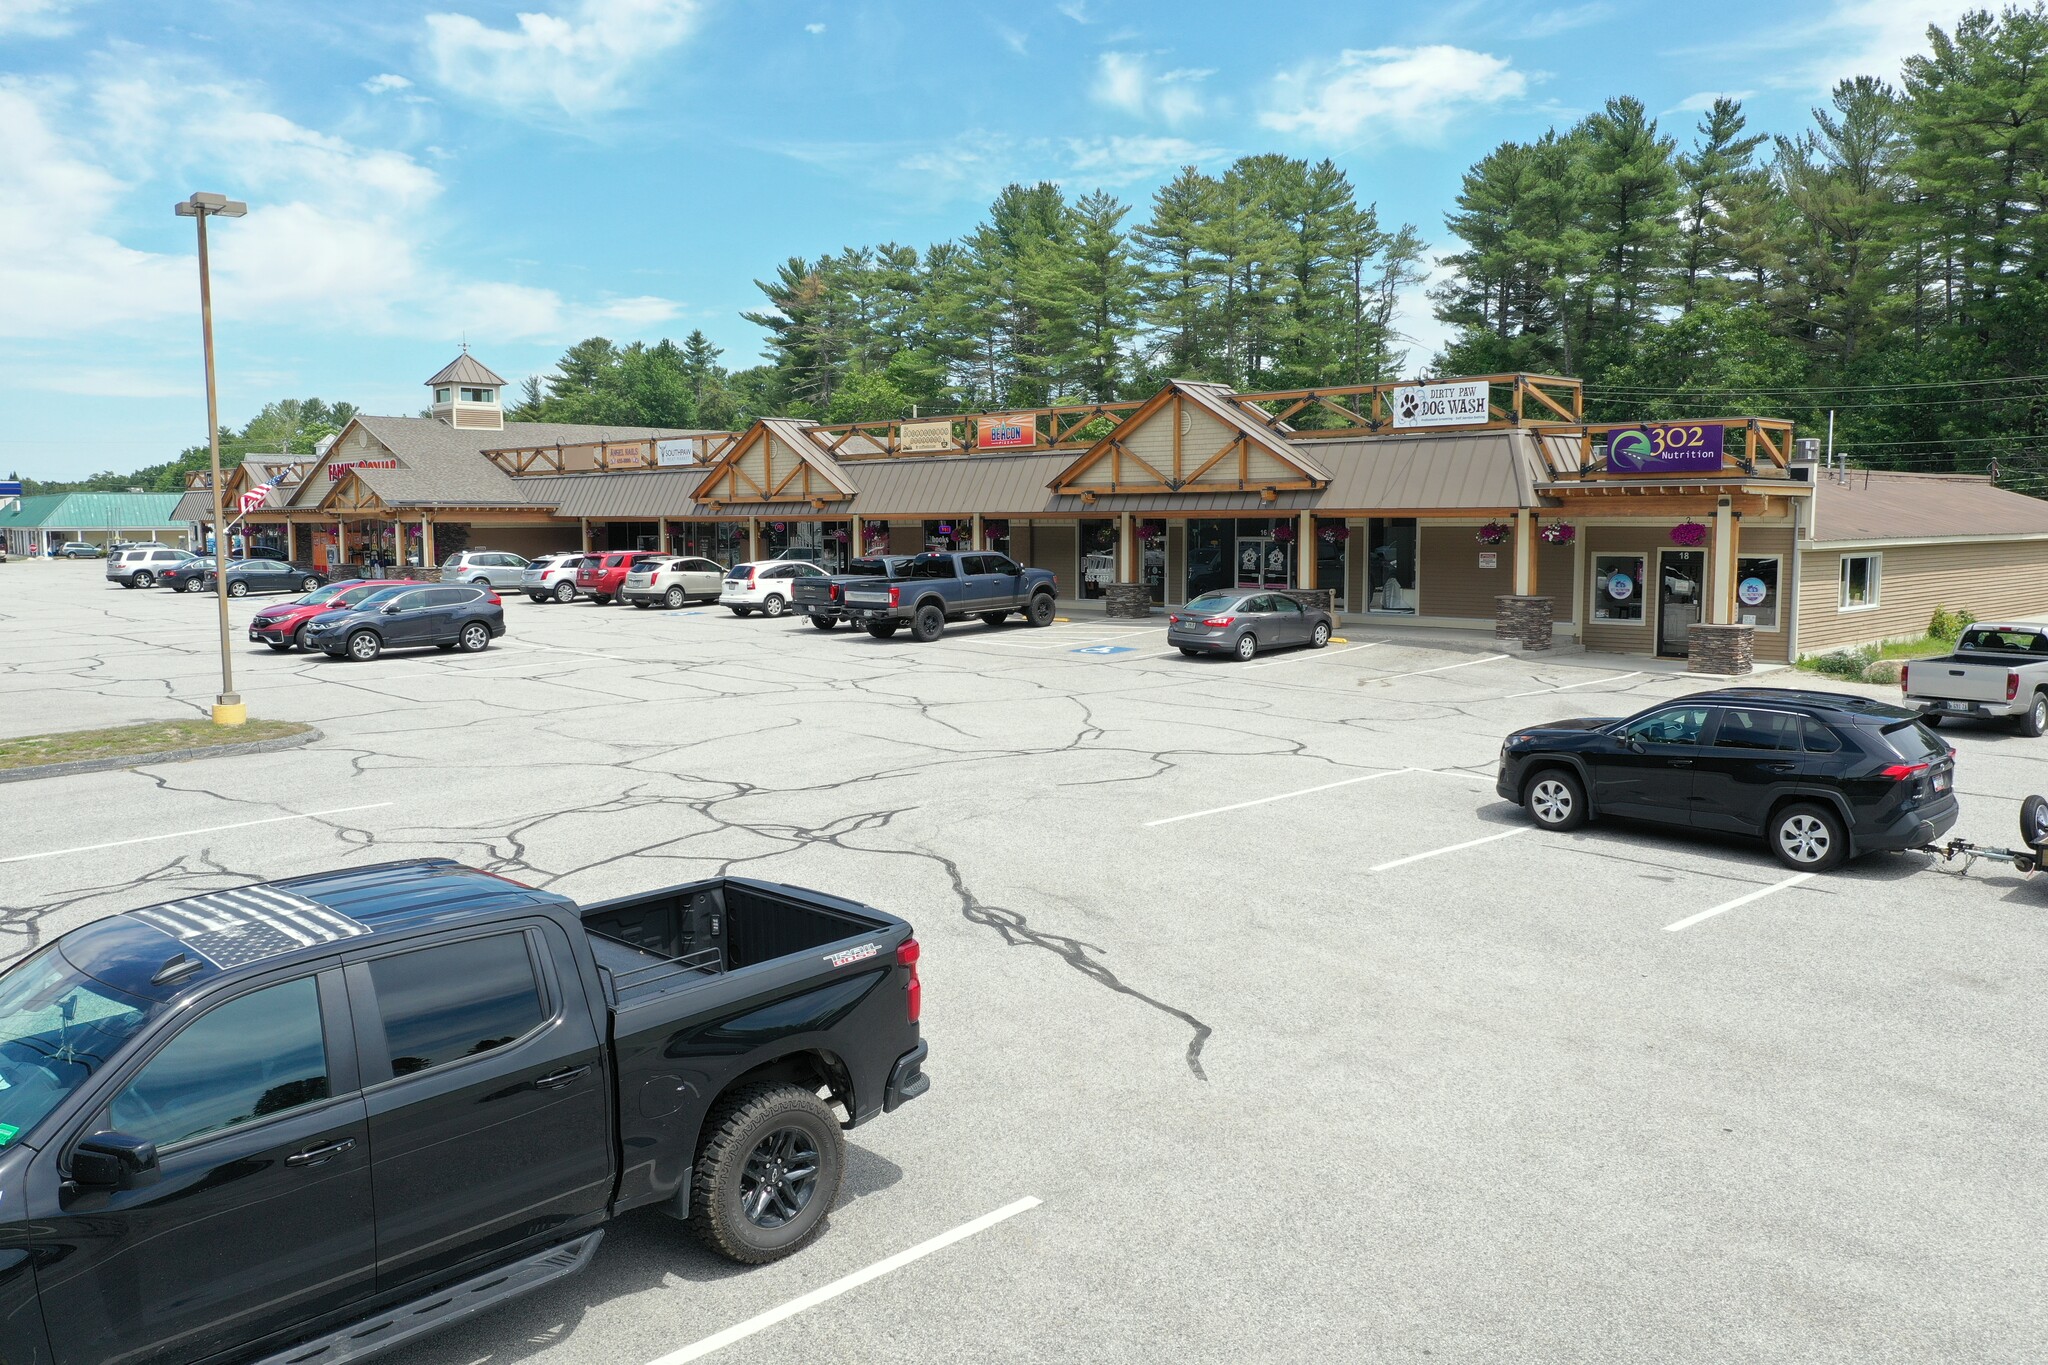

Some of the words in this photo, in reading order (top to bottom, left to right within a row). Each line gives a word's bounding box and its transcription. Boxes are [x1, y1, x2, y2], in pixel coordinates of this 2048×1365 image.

[1430, 388, 1455, 399] DIRTY
[1458, 386, 1477, 397] PAW
[1421, 400, 1446, 416] DOG
[1447, 398, 1485, 415] WASH
[991, 423, 1021, 441] BEACON
[1650, 426, 1704, 456] 302
[1661, 450, 1714, 459] Nutrition
[1679, 551, 1690, 560] 18
[1080, 556, 1114, 573] PIZZA
